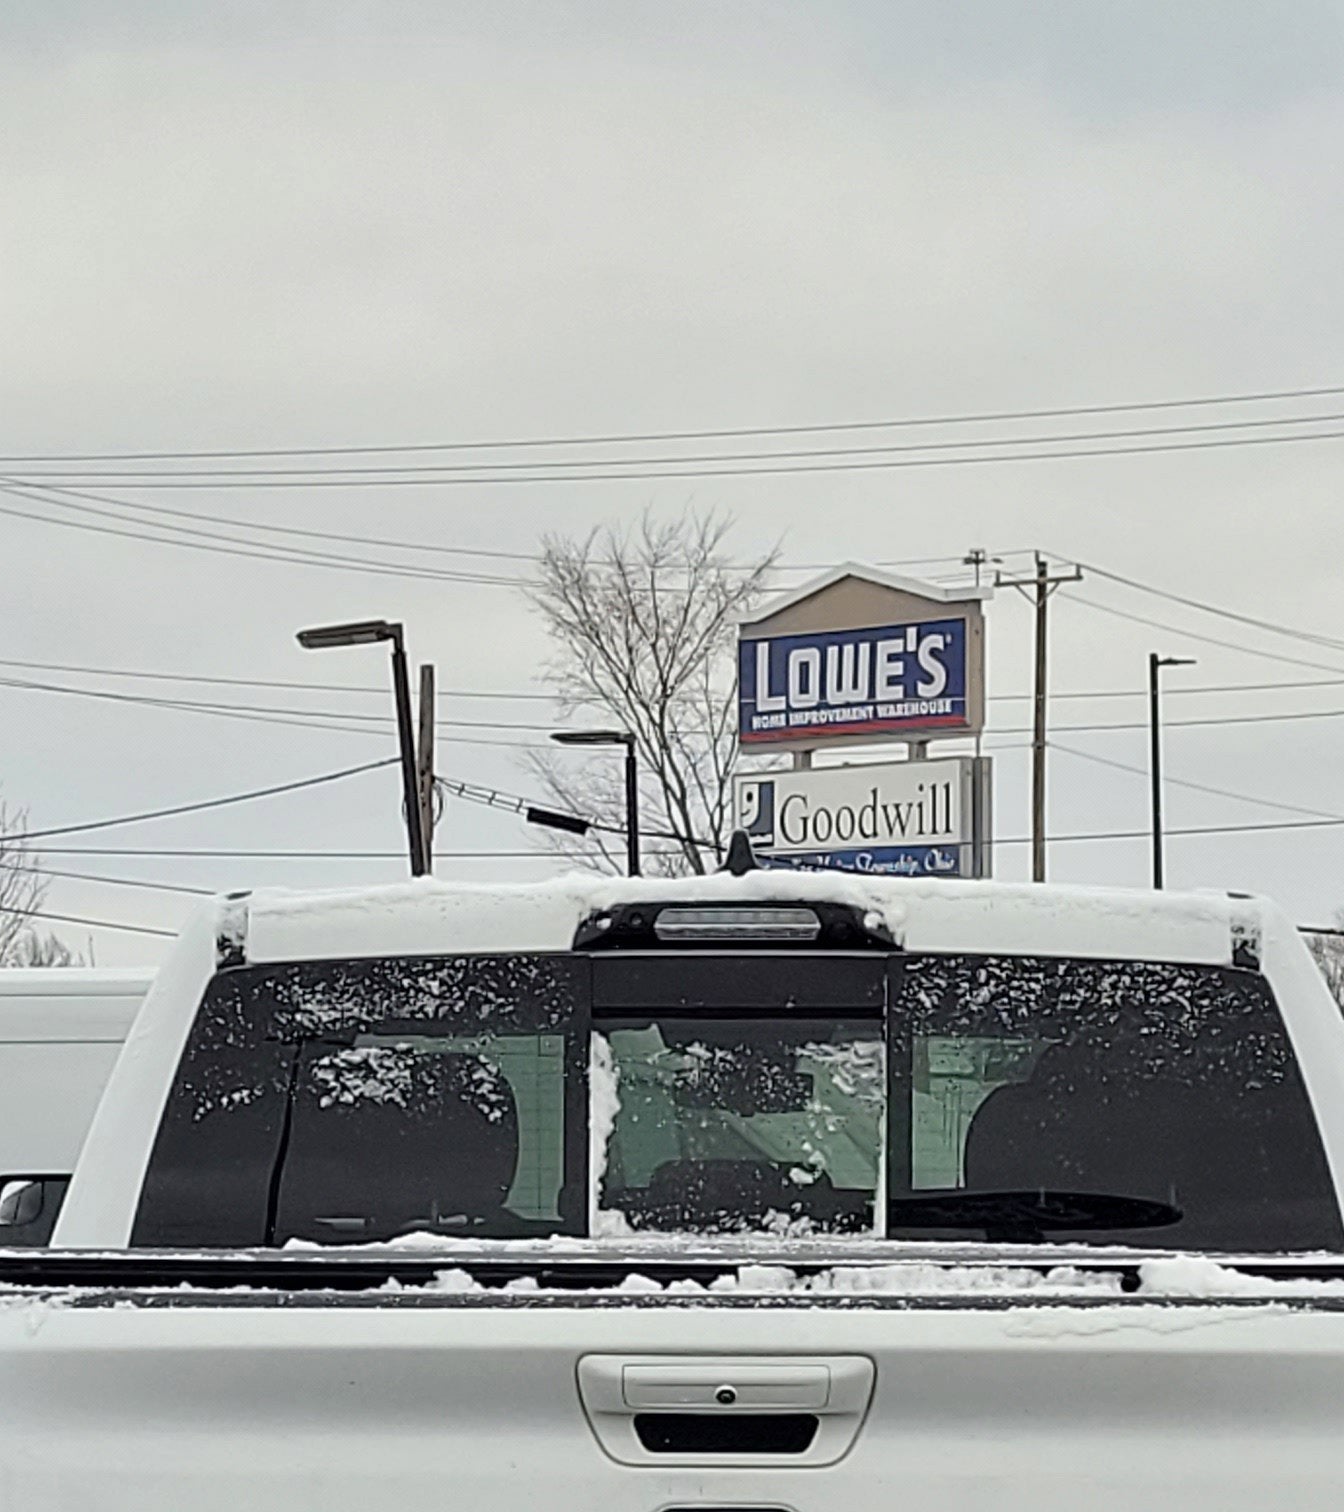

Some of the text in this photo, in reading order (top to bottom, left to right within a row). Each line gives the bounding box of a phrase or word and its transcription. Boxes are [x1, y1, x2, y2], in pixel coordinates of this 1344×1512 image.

[755, 626, 948, 713] LOWE'S
[752, 699, 953, 730] HOME IMPROVEMENT WAREHOUSE
[779, 781, 953, 845] Goodwill
